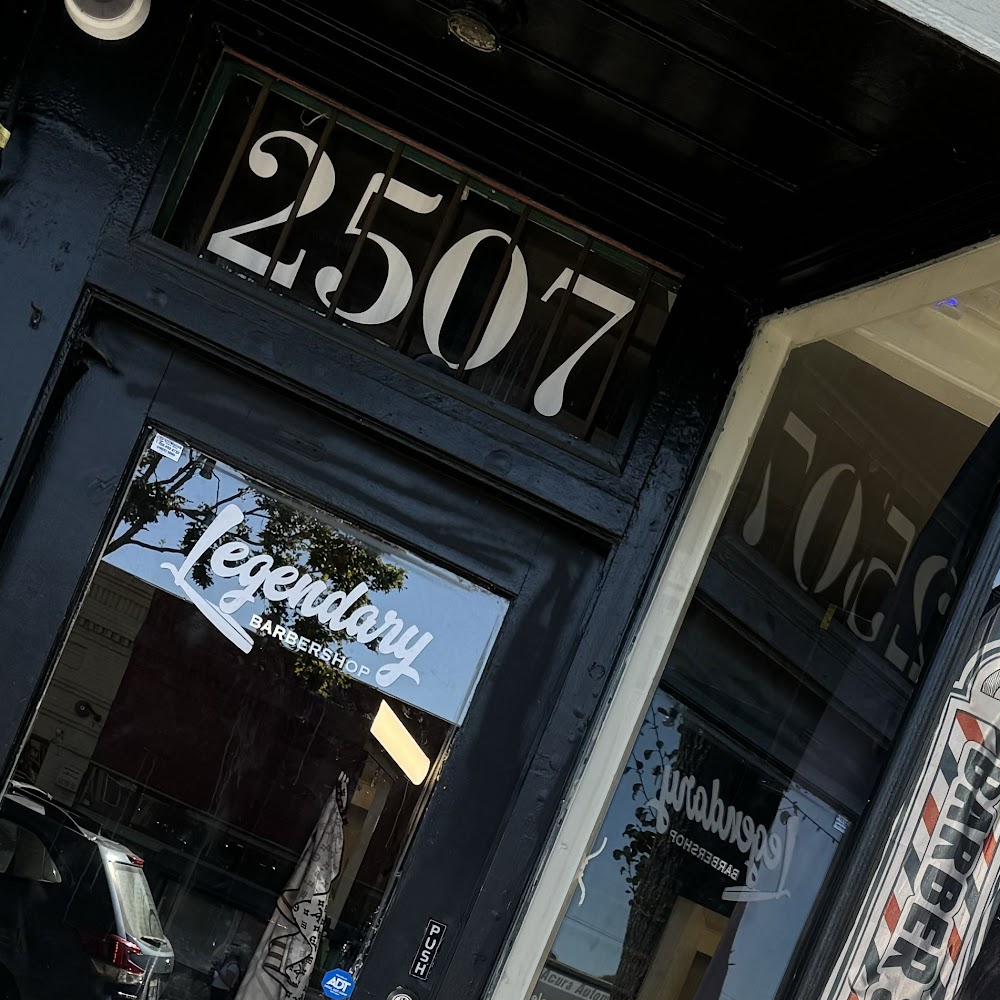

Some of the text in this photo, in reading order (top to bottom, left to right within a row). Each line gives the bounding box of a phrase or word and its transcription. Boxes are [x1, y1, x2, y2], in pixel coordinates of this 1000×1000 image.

[207, 130, 635, 417] 2507
[160, 503, 434, 688] Legendary
[249, 613, 371, 677] BARBERSHOP
[414, 924, 441, 976] PUSH
[541, 968, 574, 990] Acura
[326, 976, 352, 992] ADT
